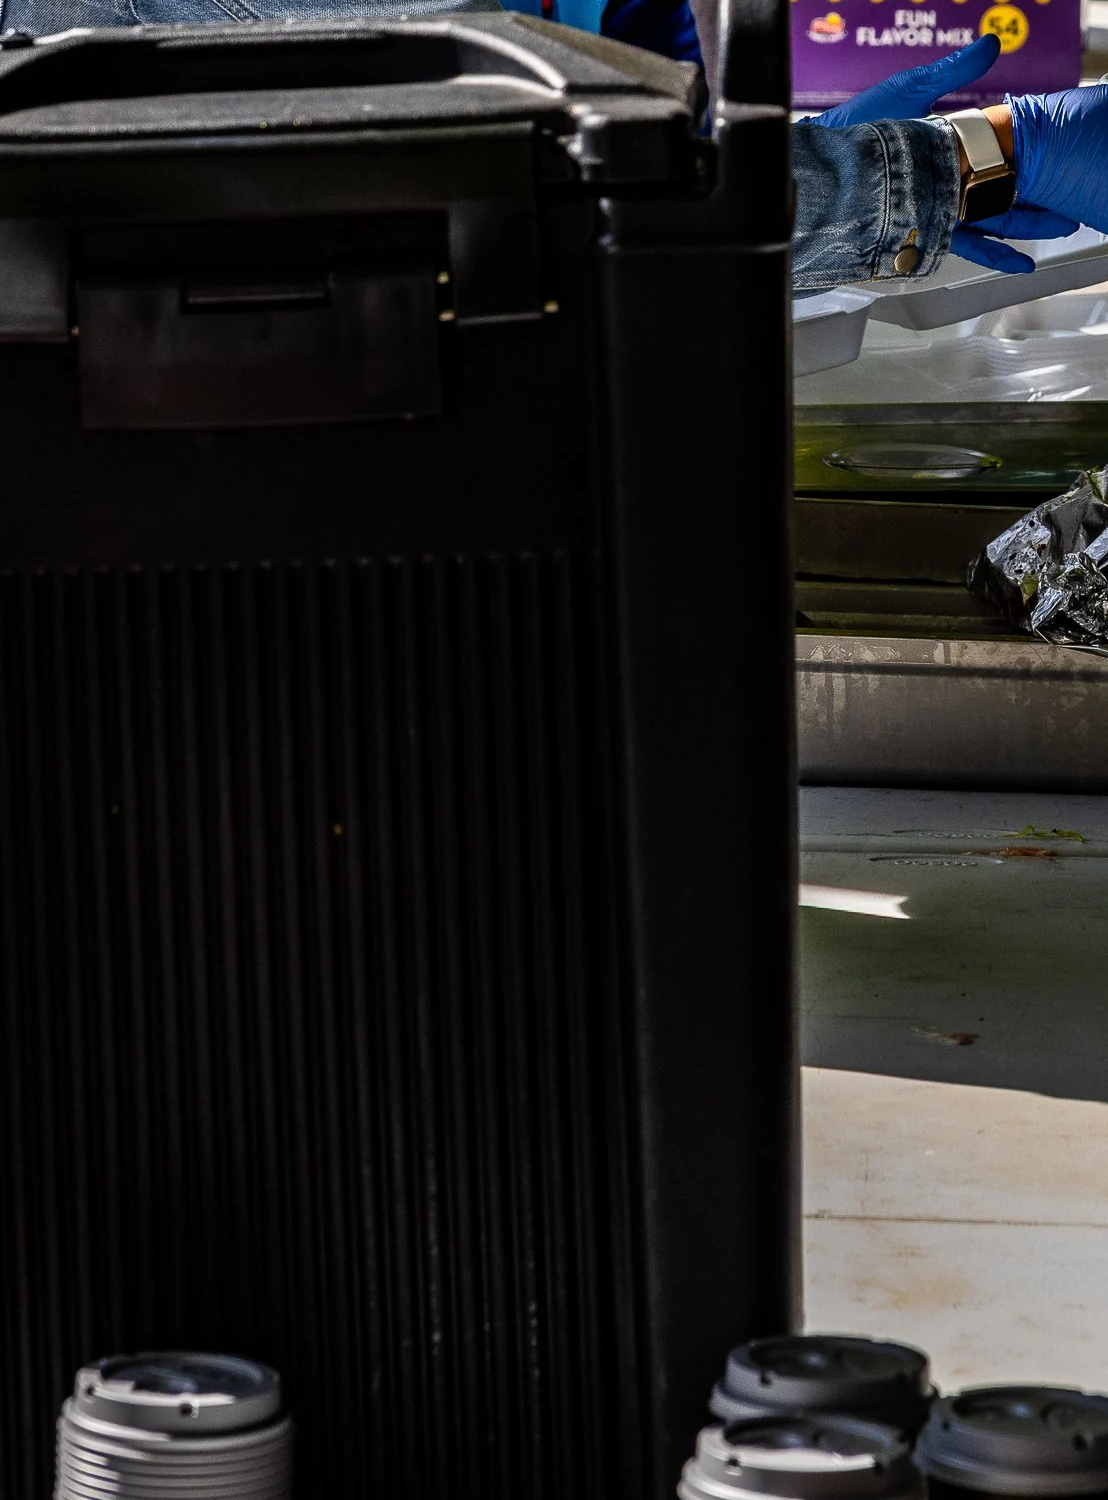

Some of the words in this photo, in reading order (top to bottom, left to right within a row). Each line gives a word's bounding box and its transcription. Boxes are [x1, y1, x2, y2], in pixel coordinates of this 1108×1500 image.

[894, 8, 937, 28] FUN
[855, 26, 934, 47] FLAVOR
[936, 27, 974, 48] MIX
